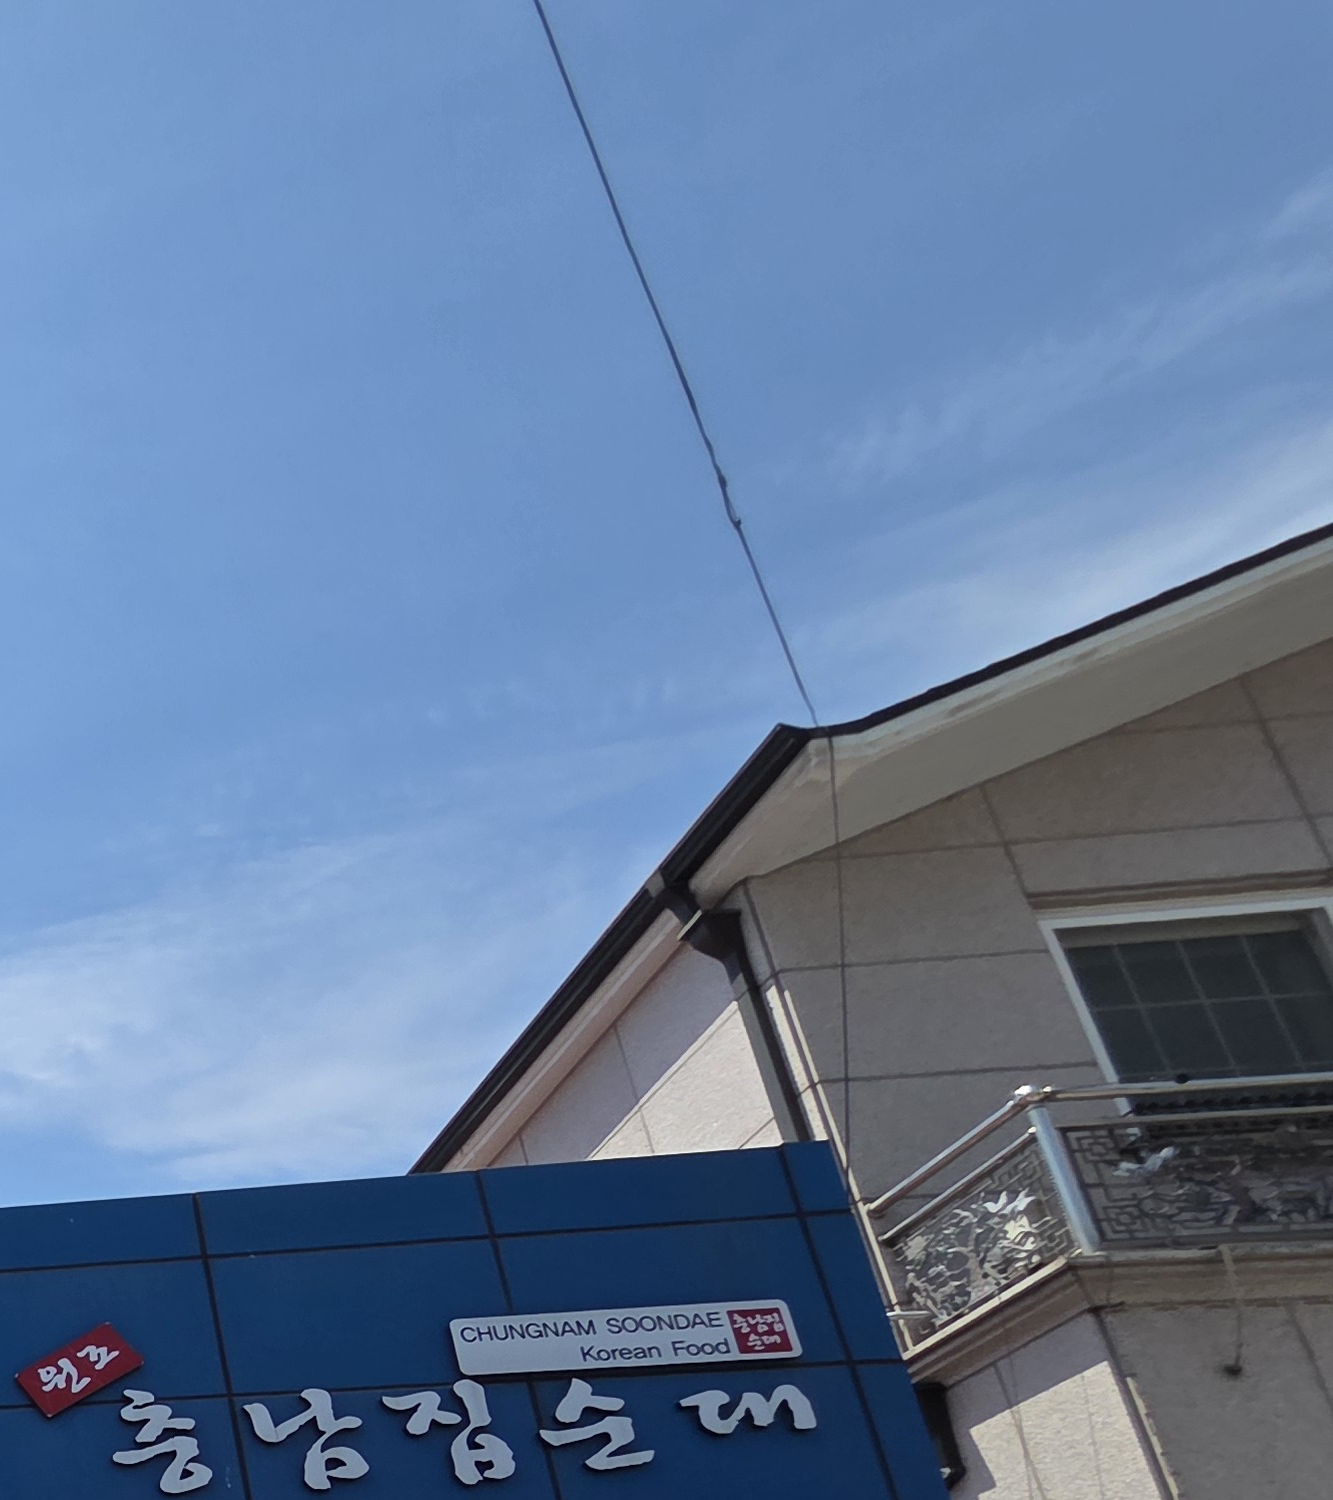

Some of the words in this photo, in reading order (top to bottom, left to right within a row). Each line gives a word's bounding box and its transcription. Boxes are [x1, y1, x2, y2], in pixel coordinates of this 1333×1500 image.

[459, 1318, 596, 1344] CHUNGNAM
[606, 1311, 724, 1336] SOONDAE
[732, 1312, 785, 1334] 충남집
[579, 1345, 661, 1362] Korean
[672, 1338, 731, 1357] Food
[746, 1333, 781, 1351] 순대
[37, 1341, 119, 1394] 원조
[112, 1377, 817, 1495] 충남집순대
